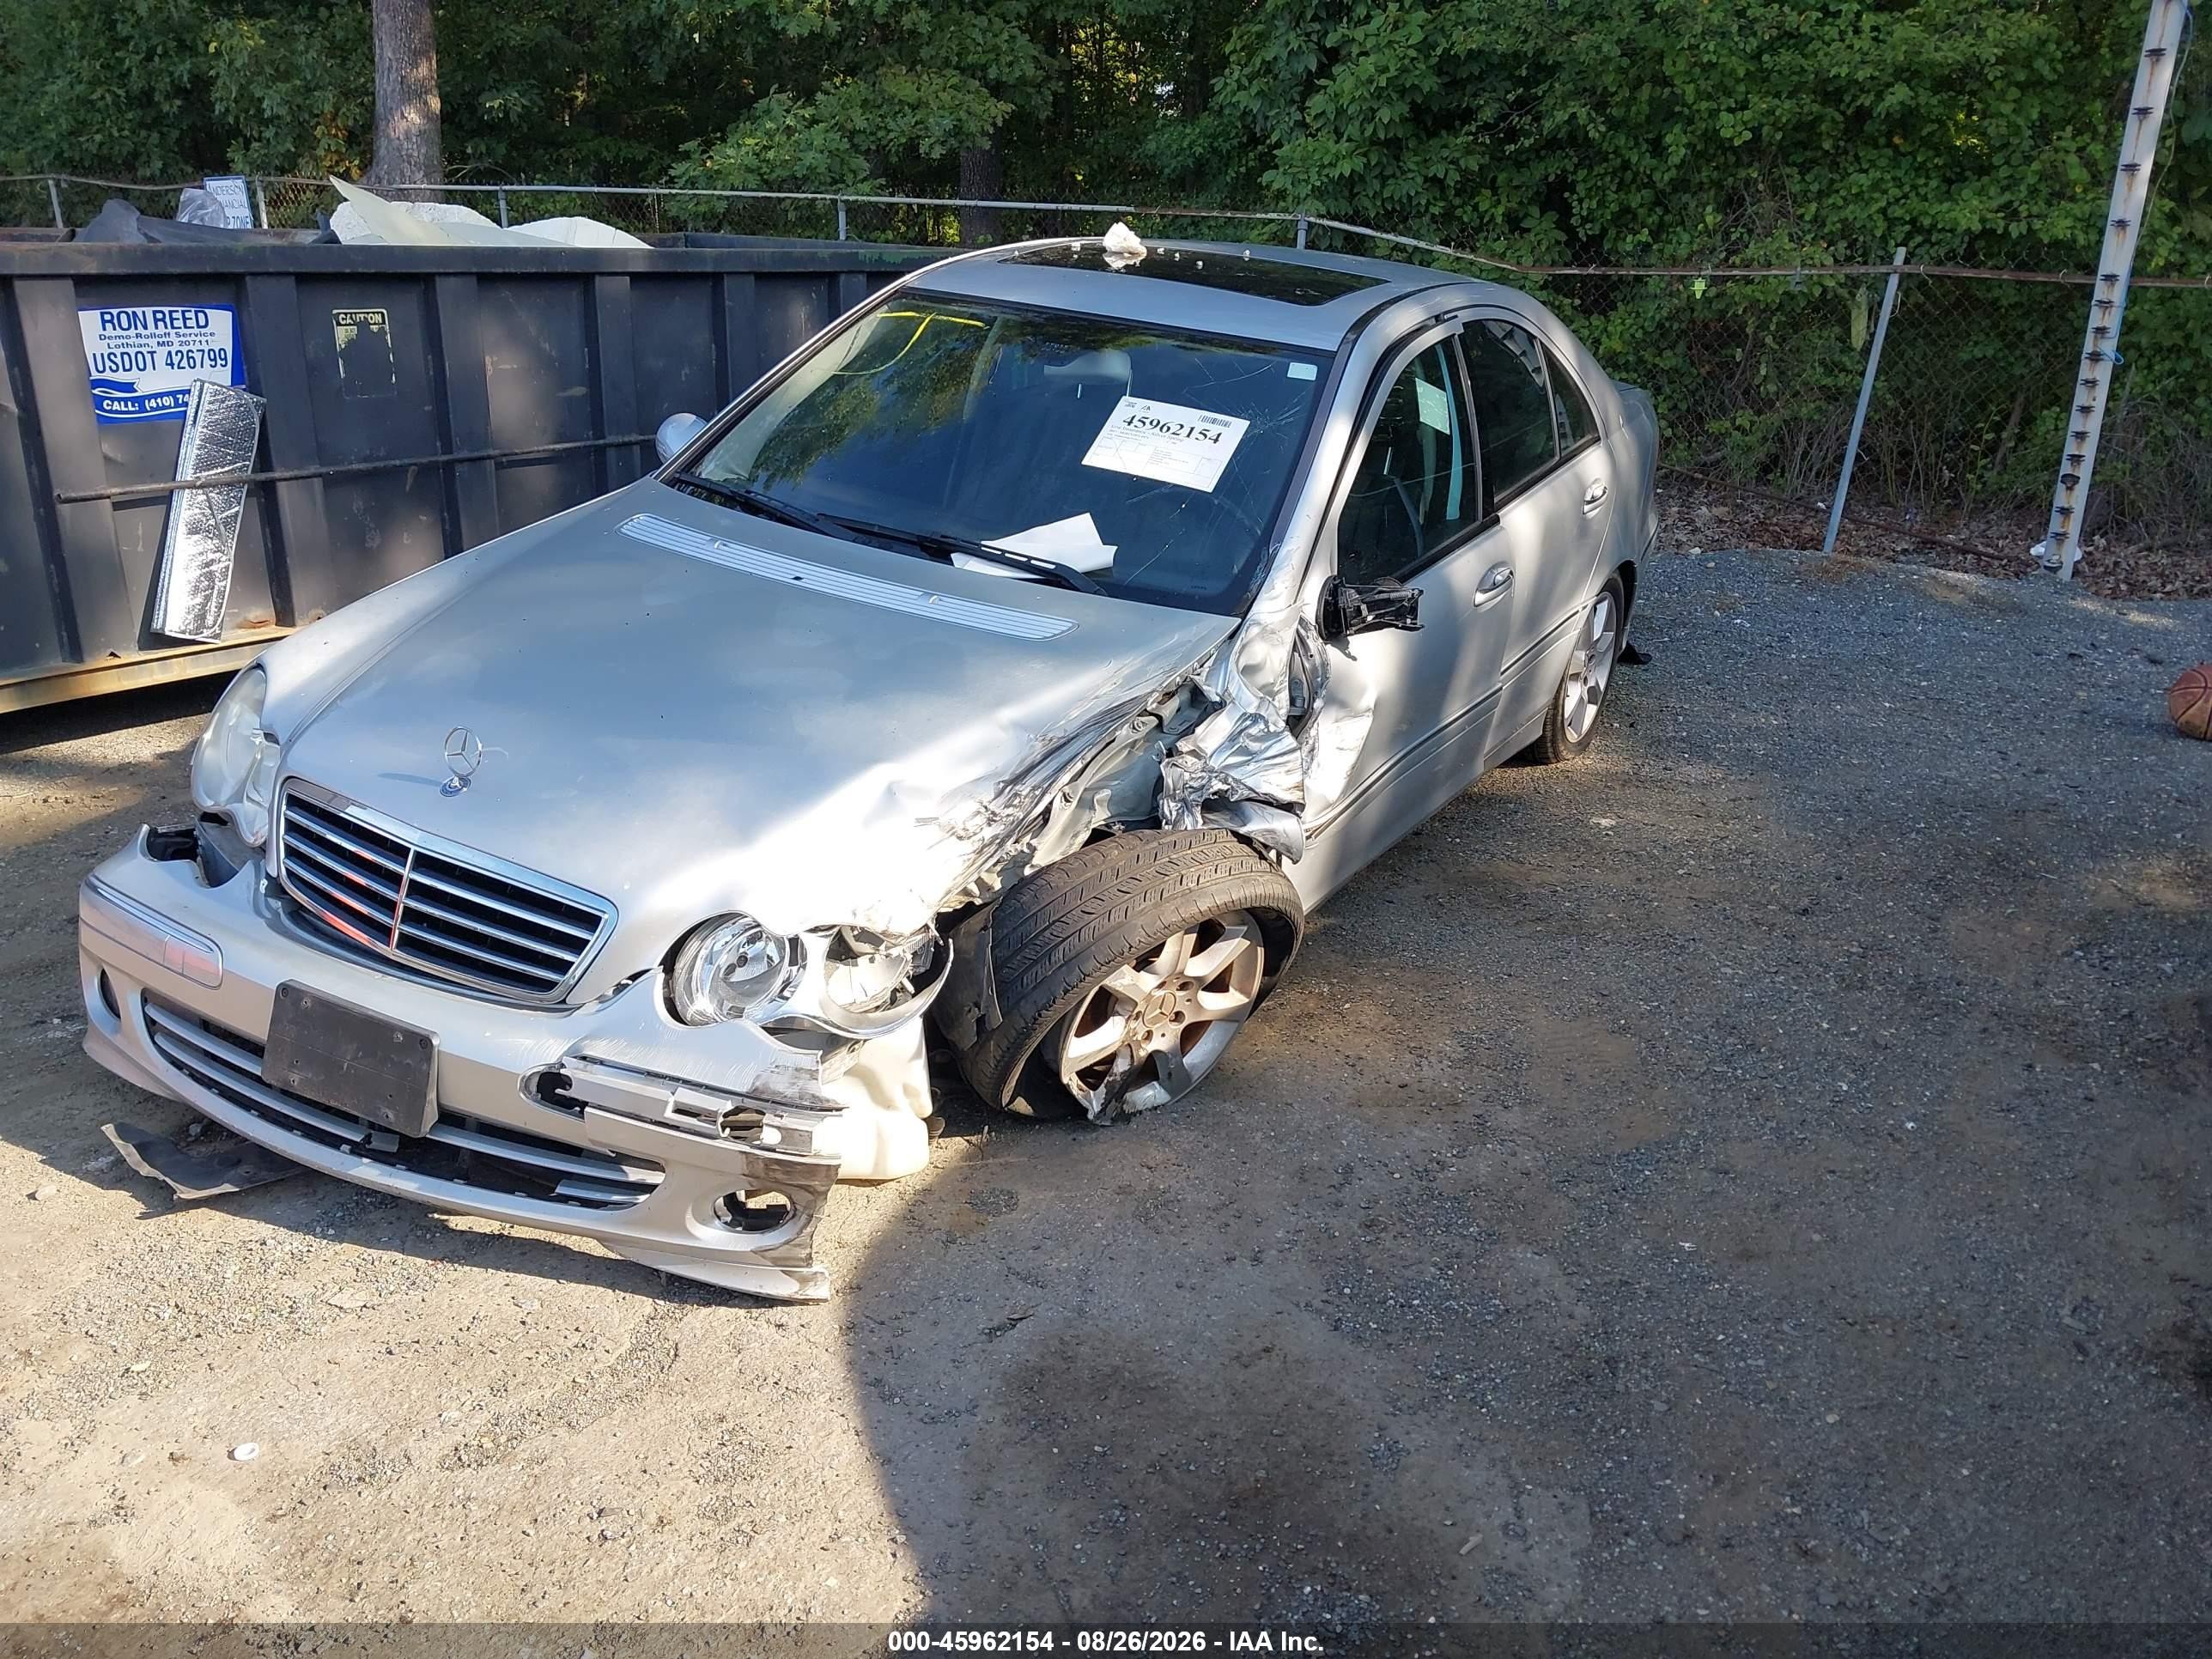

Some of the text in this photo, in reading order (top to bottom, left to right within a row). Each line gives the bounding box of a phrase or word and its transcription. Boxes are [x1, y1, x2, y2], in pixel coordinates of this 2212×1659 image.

[100, 309, 209, 331] RON REED
[338, 313, 382, 325] CAUTON
[99, 332, 171, 341] Demo-Rolloff
[93, 348, 228, 374] USDOT 426799
[103, 399, 139, 411] CALL:
[144, 396, 174, 410] (410)
[1122, 414, 1223, 444] 45962154
